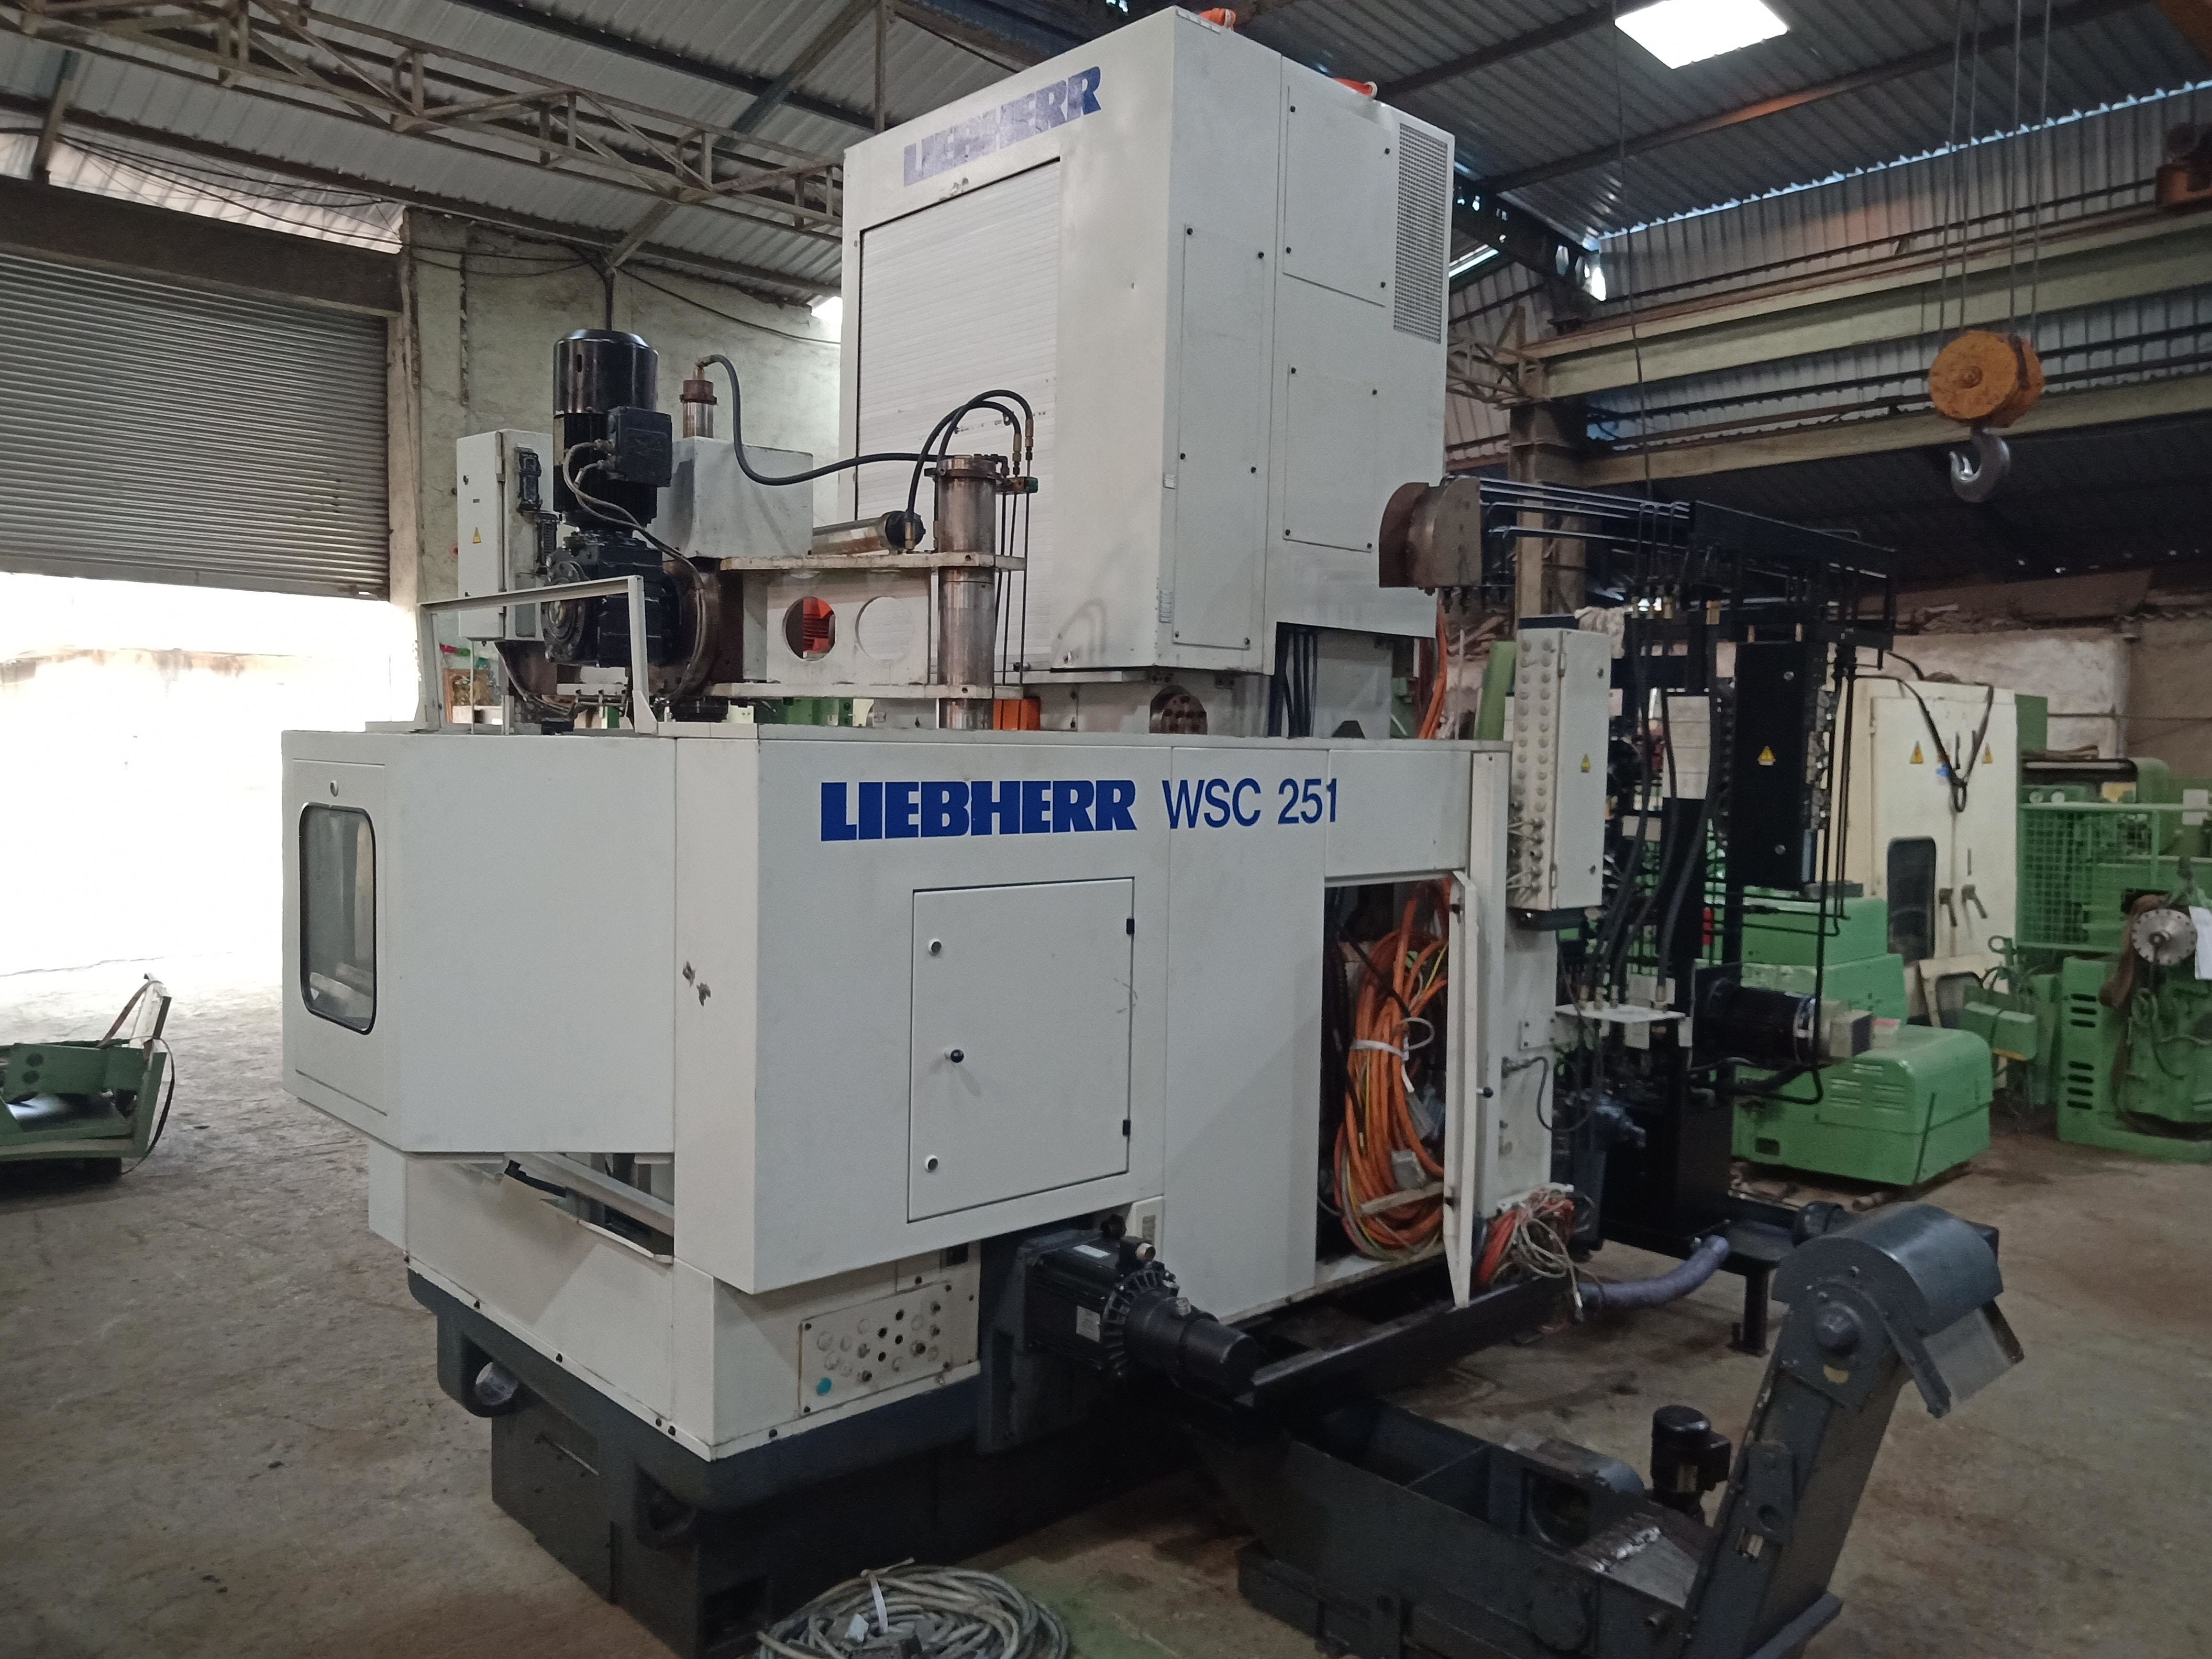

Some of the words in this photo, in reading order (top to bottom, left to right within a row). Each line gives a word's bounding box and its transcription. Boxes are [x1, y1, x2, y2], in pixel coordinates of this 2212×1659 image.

[904, 67, 1101, 187] LIEBHERR
[821, 780, 1137, 842] LIEBHERR
[1162, 778, 1261, 829] WSC
[1278, 779, 1337, 824] 251
